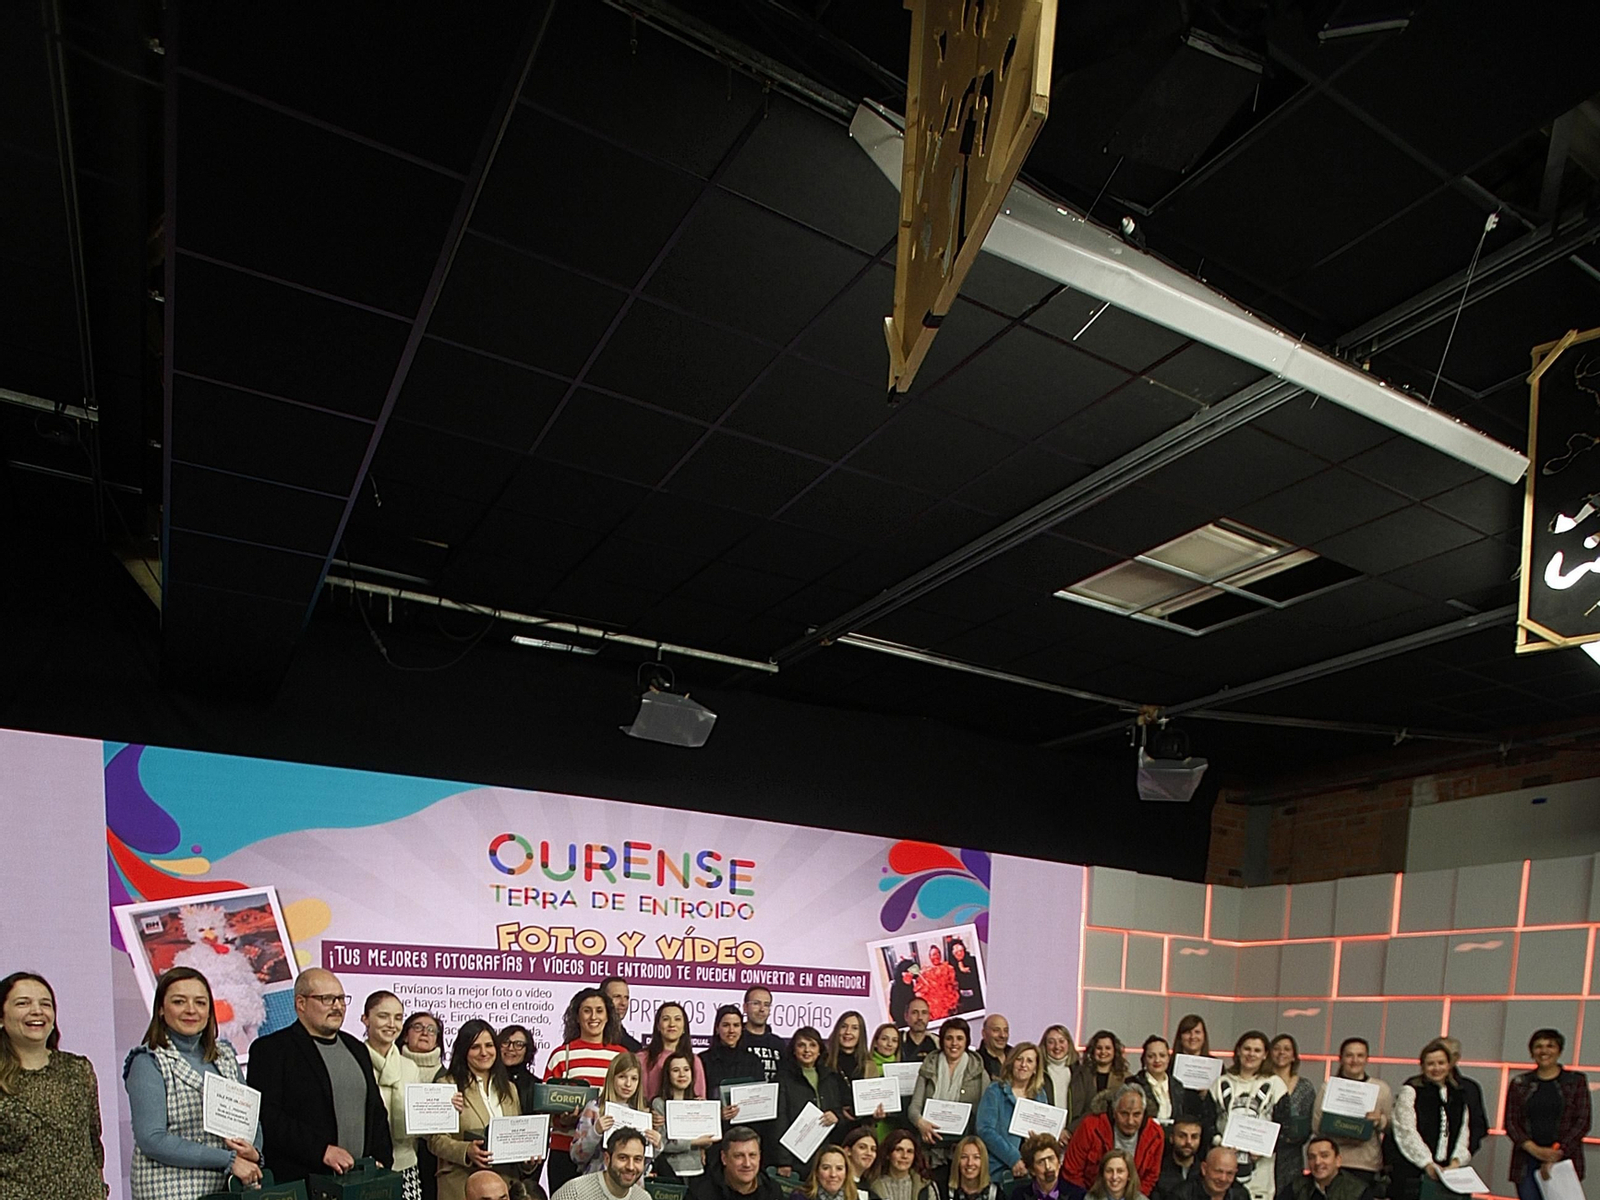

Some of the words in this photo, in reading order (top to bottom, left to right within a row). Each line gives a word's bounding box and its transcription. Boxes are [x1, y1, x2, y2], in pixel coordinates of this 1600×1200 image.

[488, 832, 755, 896] OURENSE
[489, 883, 577, 910] TERRA
[592, 891, 625, 911] DE
[639, 895, 754, 920] ENTROIDO
[496, 922, 607, 957] FOTO
[617, 931, 645, 958] Y
[656, 926, 764, 965] VÍDEO
[367, 949, 428, 968] MEJORES
[435, 952, 523, 973] FOTOGRAFÍAS
[528, 957, 536, 973] Y
[543, 955, 584, 975] VÍDEOS
[590, 960, 611, 976] DEL
[617, 962, 671, 980] ENTROIDO
[676, 965, 691, 981] TE
[696, 967, 736, 983] PUEDEN
[740, 969, 795, 986] CONVERTIR
[799, 972, 813, 986] EN
[817, 973, 866, 990] GANADOR!
[393, 982, 443, 995] Envíanos
[446, 984, 456, 995] la
[458, 985, 488, 998] mejor
[492, 985, 513, 998] foto
[515, 988, 522, 998] o
[525, 987, 552, 999] vídeo
[414, 997, 447, 1011] hayas
[449, 998, 483, 1009] hecho
[485, 1001, 498, 1010] en
[500, 1000, 510, 1010] el
[512, 1000, 554, 1012] entroido
[488, 1012, 508, 1023] Frei
[510, 1013, 552, 1026] Canedo,
